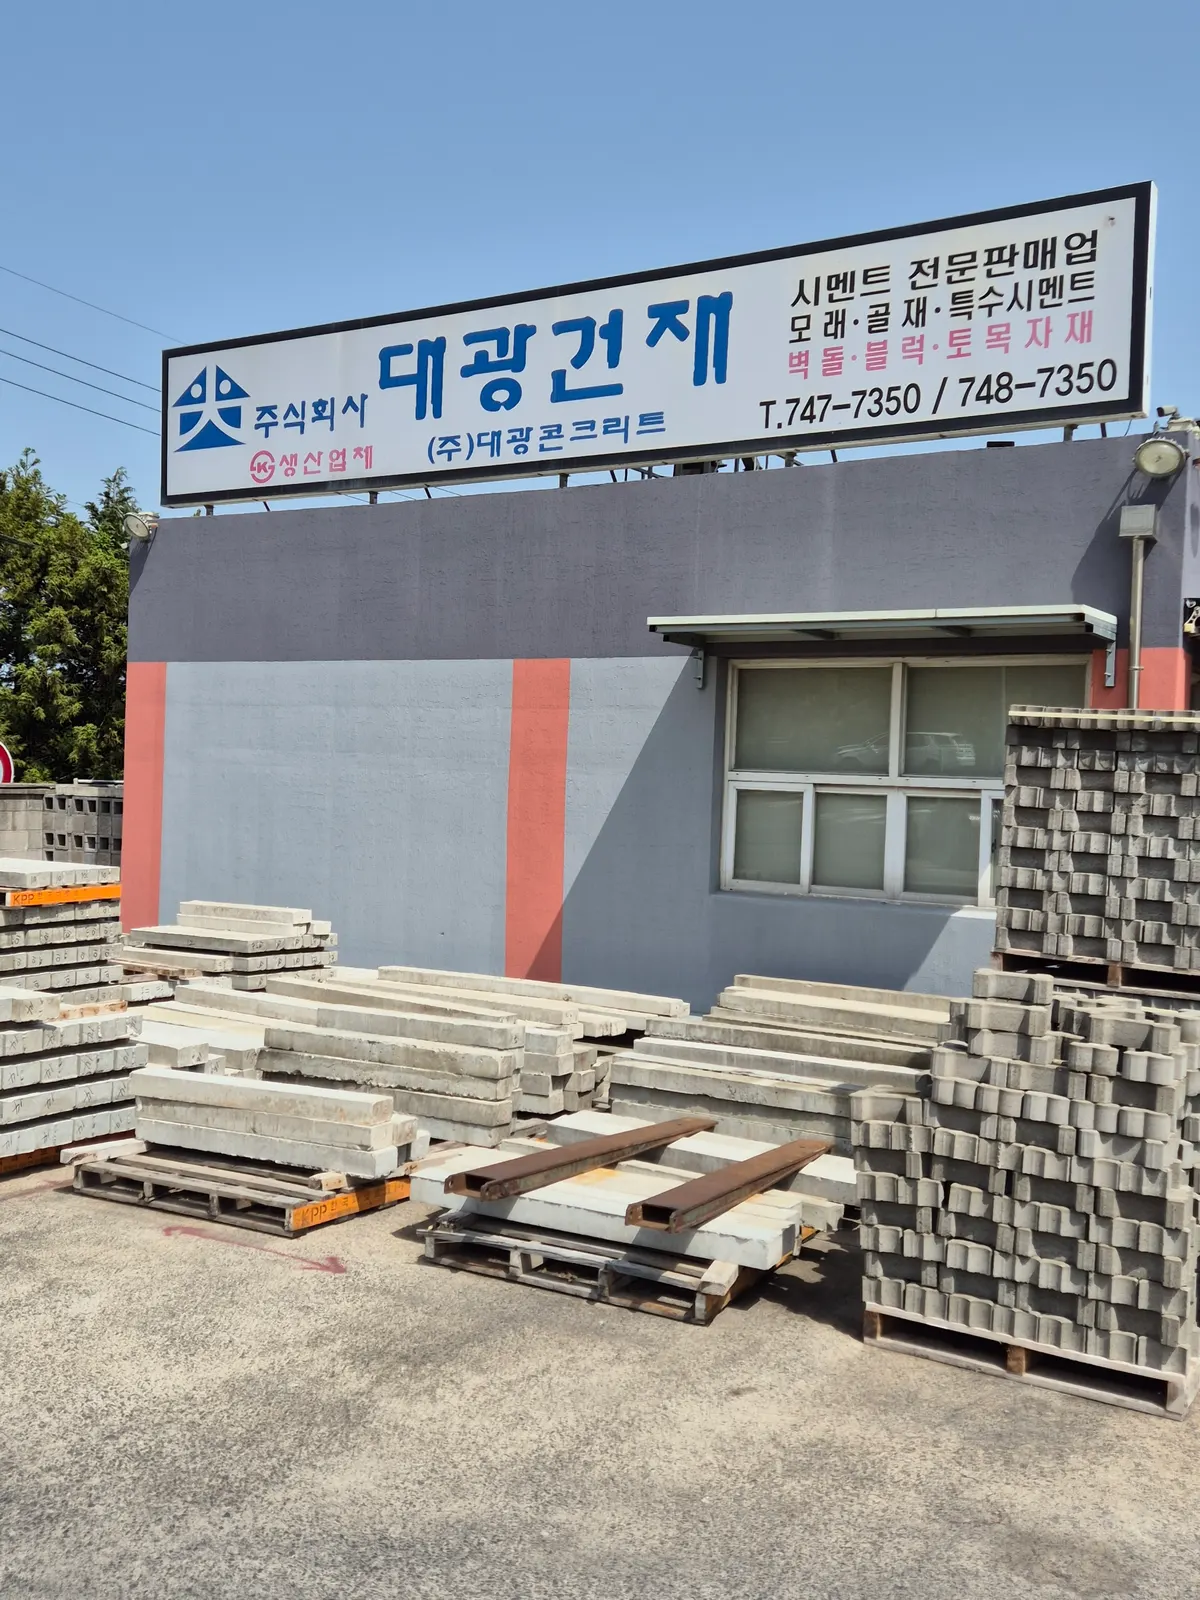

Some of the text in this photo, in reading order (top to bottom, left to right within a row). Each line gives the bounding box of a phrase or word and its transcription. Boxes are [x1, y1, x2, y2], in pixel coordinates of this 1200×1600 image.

[790, 229, 1098, 308] 시멘트 전문판매업
[255, 291, 733, 439] 주식회사 대광건재
[759, 382, 921, 429] T.747-7350
[958, 358, 1117, 407] 748-7350
[279, 445, 373, 477] 생산업체
[427, 411, 666, 464] (주)대광콘크리트
[300, 1203, 327, 1226] KPP
